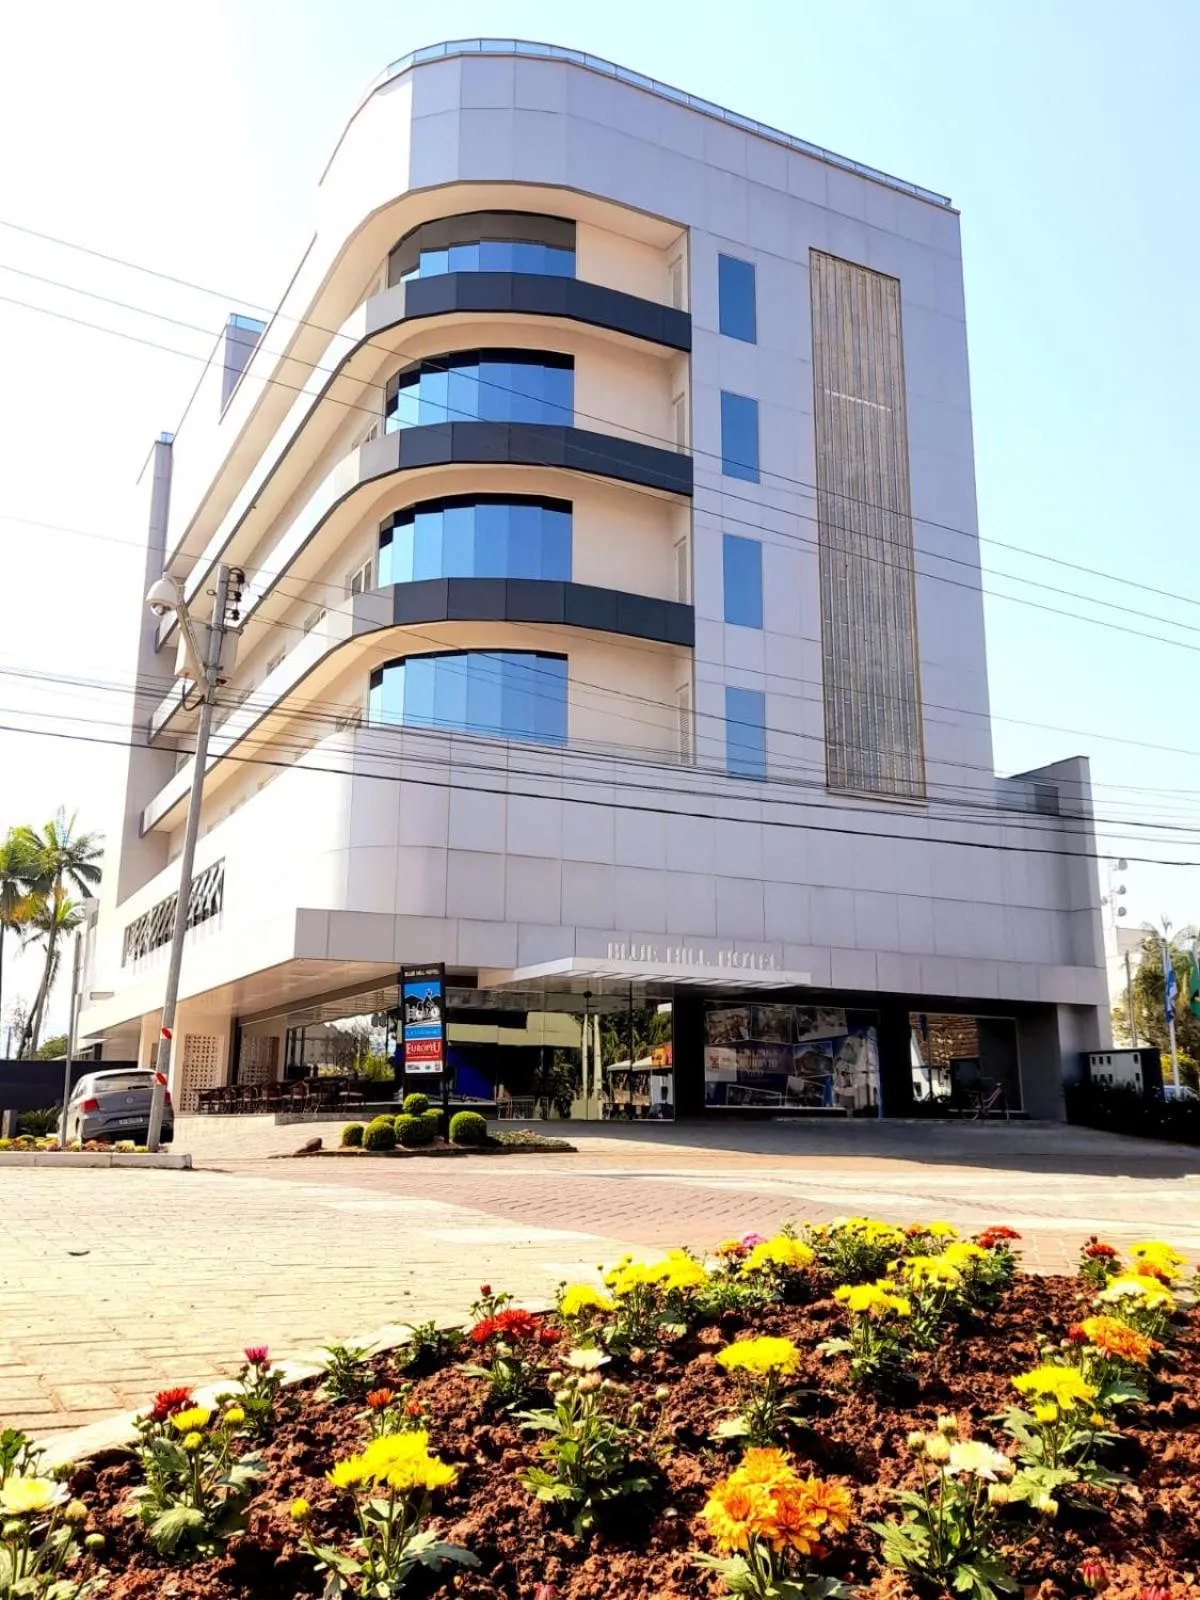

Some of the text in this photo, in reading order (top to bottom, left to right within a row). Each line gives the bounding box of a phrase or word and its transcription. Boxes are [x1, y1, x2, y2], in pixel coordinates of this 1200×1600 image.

[607, 942, 782, 970] BLUE HILL HOTEL
